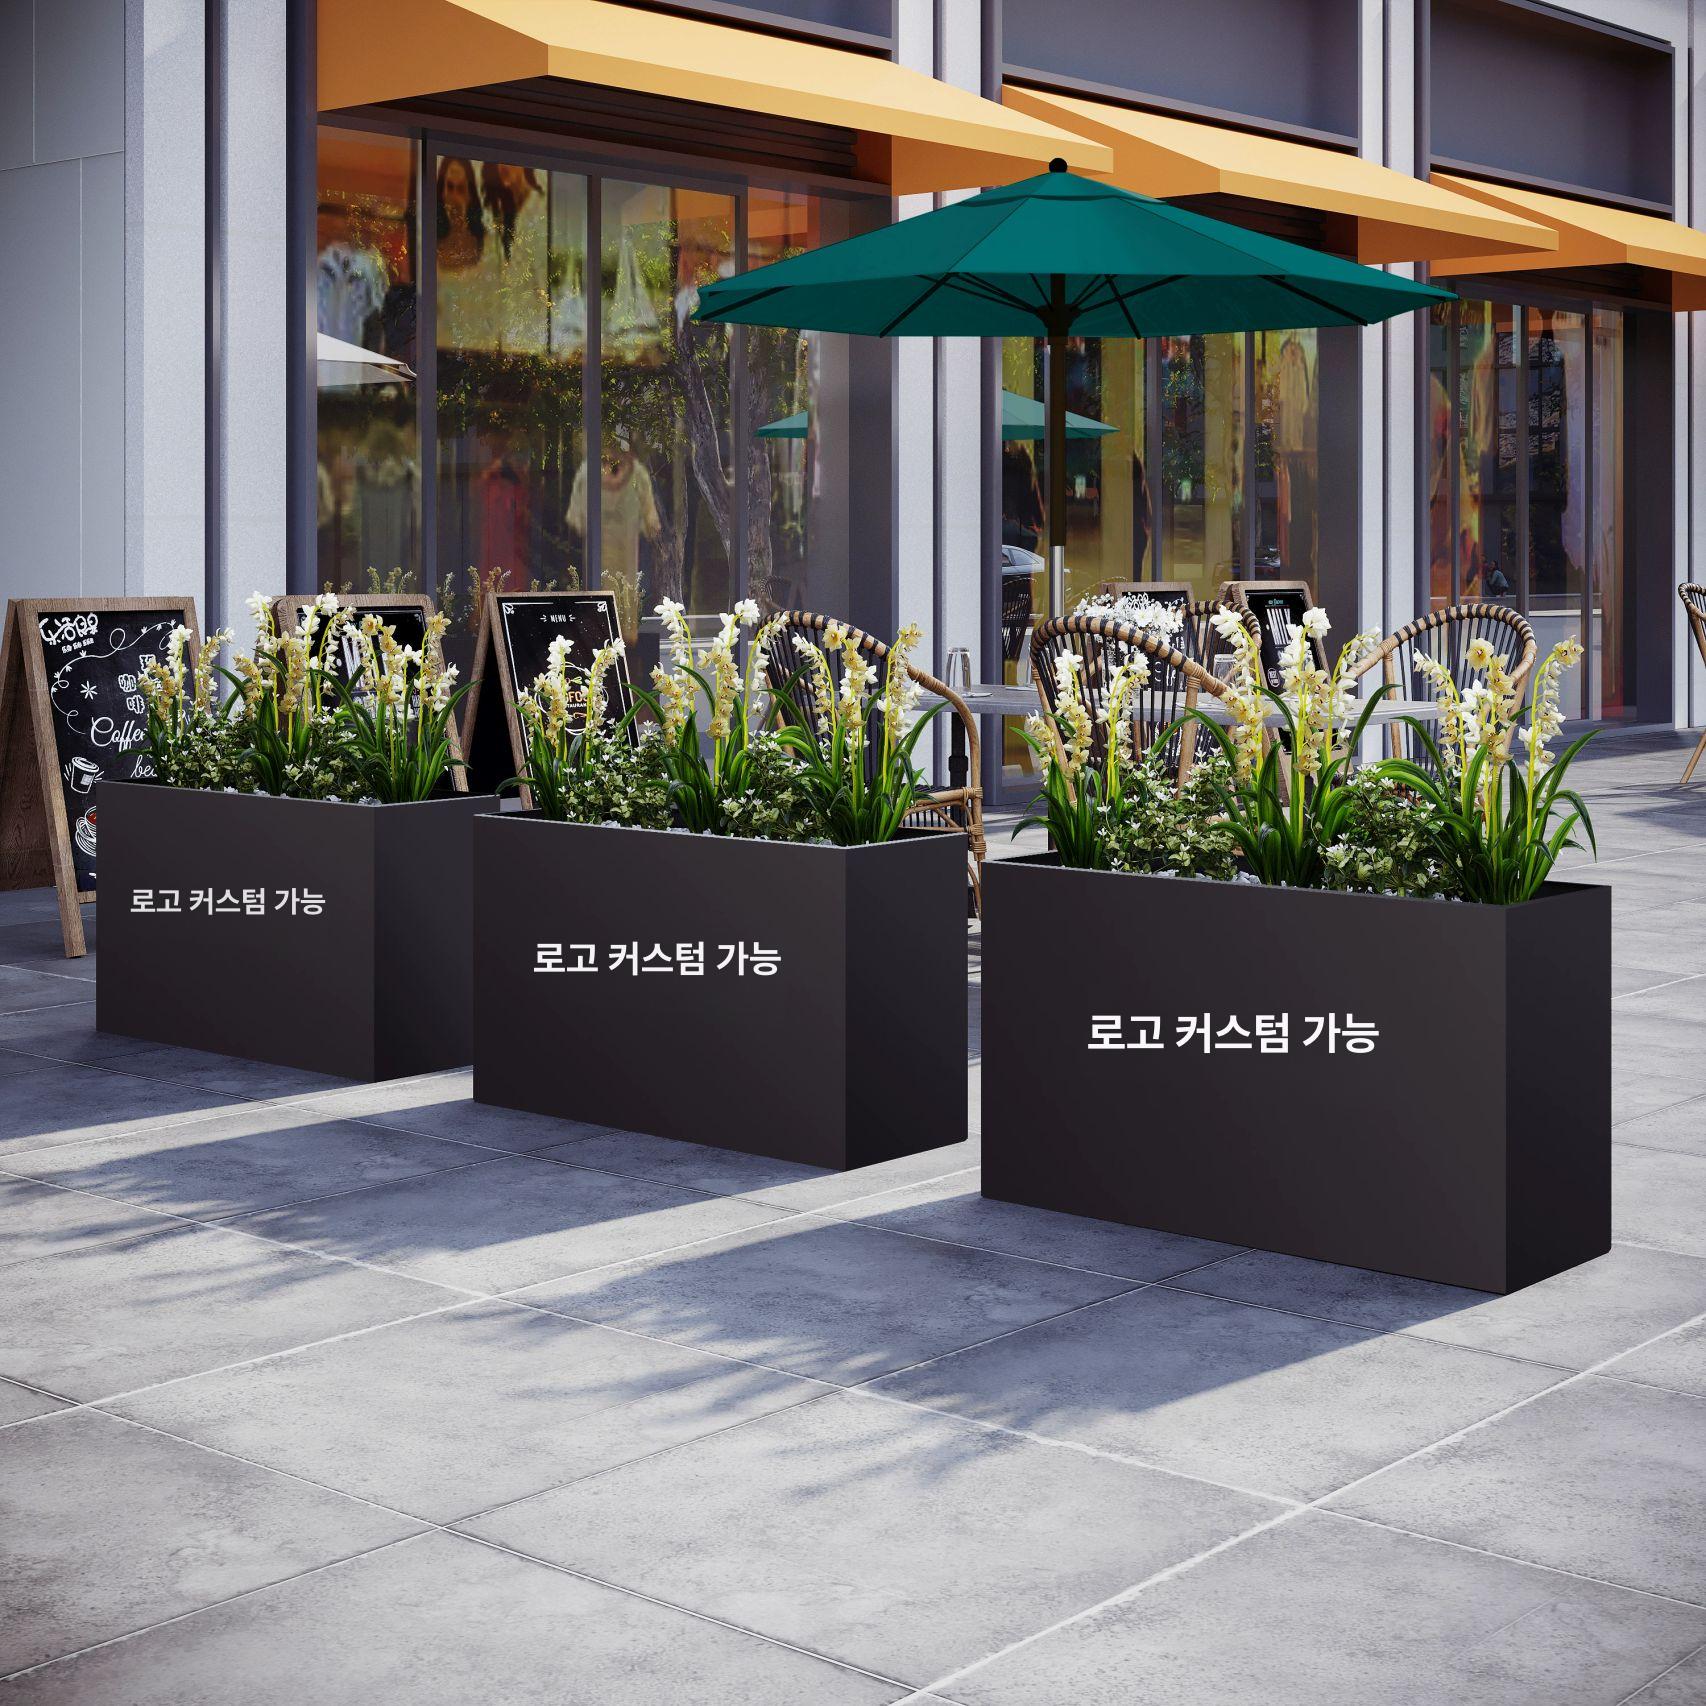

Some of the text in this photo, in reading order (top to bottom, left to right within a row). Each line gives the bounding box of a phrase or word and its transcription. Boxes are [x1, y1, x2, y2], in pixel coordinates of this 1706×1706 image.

[550, 614, 567, 623] MENU
[130, 887, 326, 916] 로고 커스텀 가능
[533, 940, 782, 977] 로고 커스텀 가능
[1087, 1012, 1380, 1054] 로고 커스텀 가능
